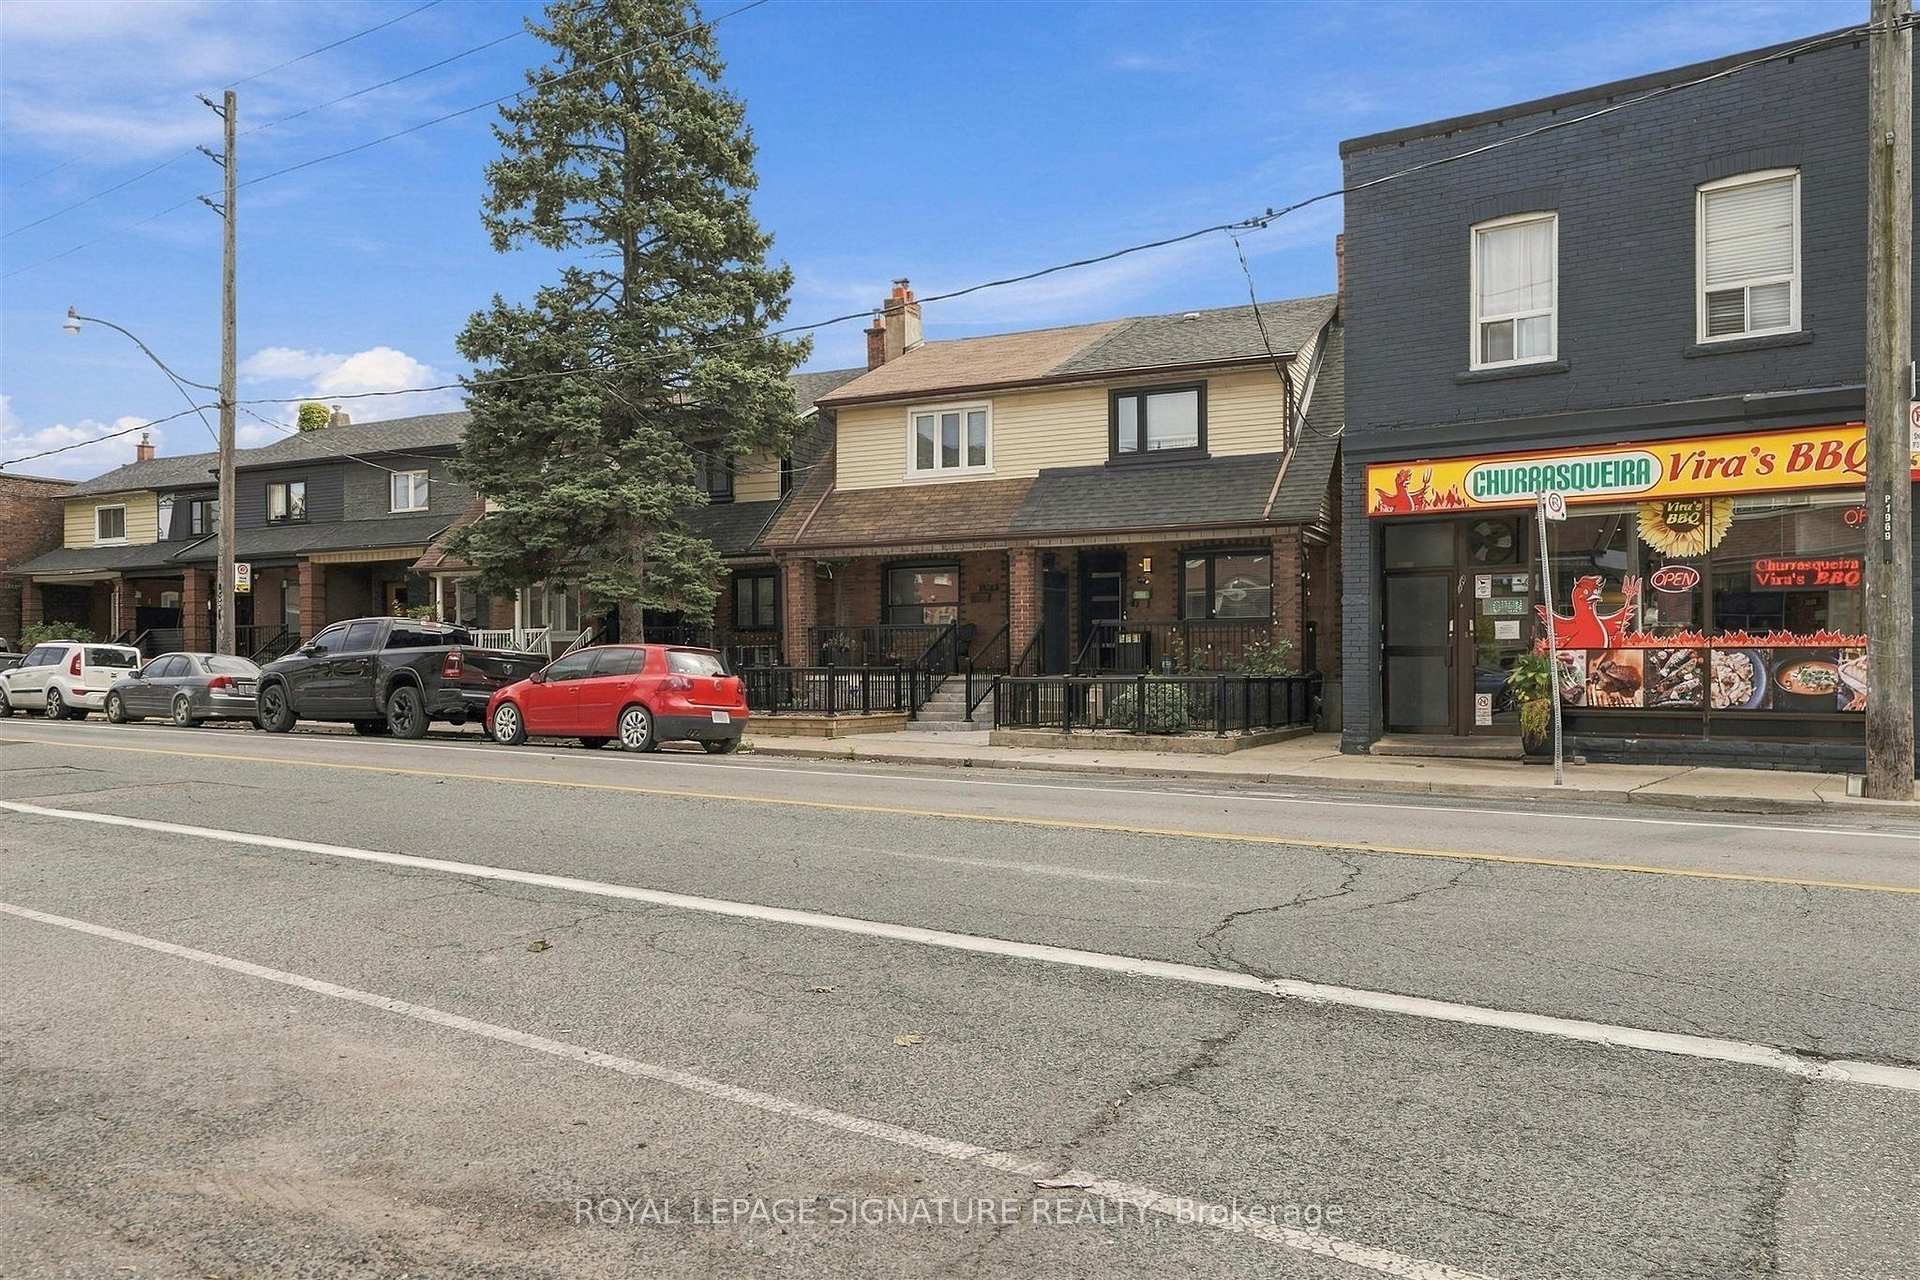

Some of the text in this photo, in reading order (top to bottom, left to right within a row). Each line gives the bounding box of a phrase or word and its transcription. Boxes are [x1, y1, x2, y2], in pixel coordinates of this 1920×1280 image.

[1668, 446, 1776, 482] Vira's
[1472, 457, 1651, 497] CHURRASQUEIRA
[1666, 512, 1700, 525] BBQ
[1653, 572, 1695, 587] OPEN
[1813, 571, 1861, 587] BBQ
